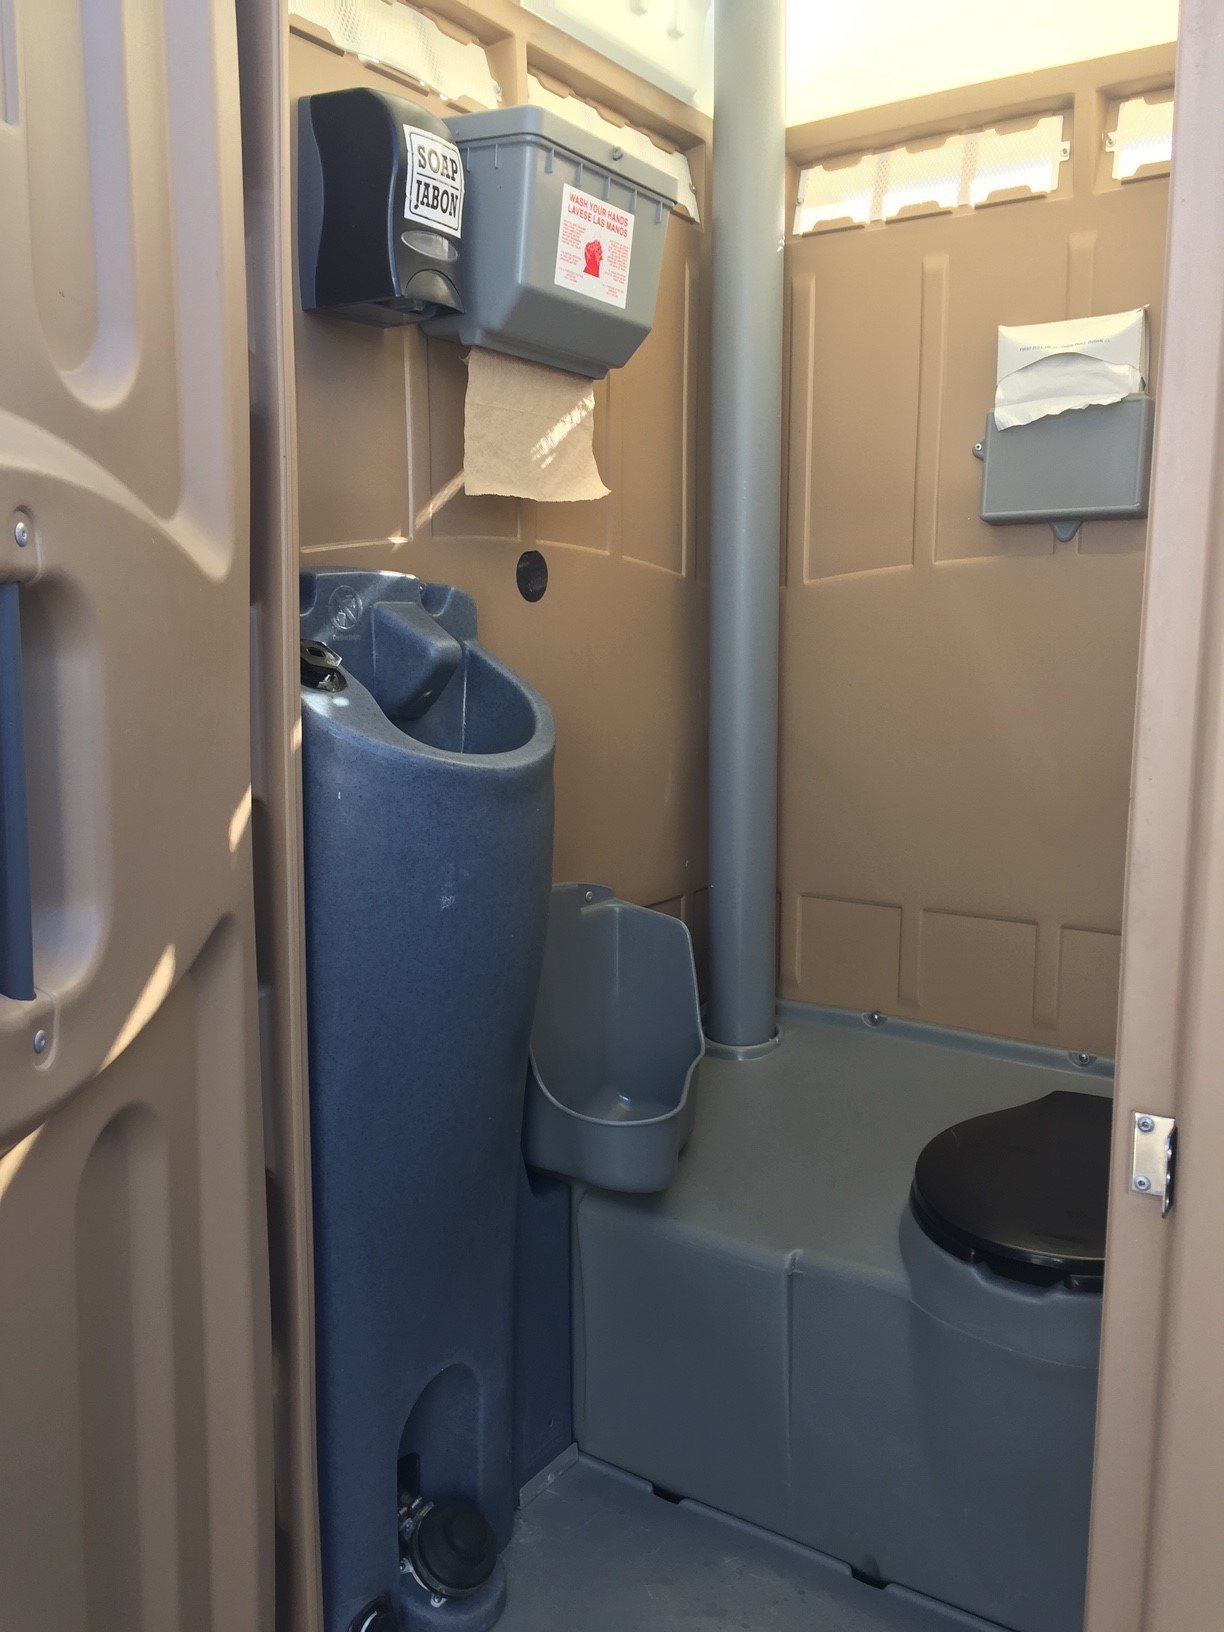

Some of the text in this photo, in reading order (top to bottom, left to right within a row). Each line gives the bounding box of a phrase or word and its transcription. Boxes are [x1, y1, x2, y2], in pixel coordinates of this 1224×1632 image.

[417, 145, 458, 182] SOAP
[414, 180, 458, 218] JABON
[569, 193, 628, 227] WASH YOUR HANDS
[568, 204, 628, 238] LAVESE LAS MANOS
